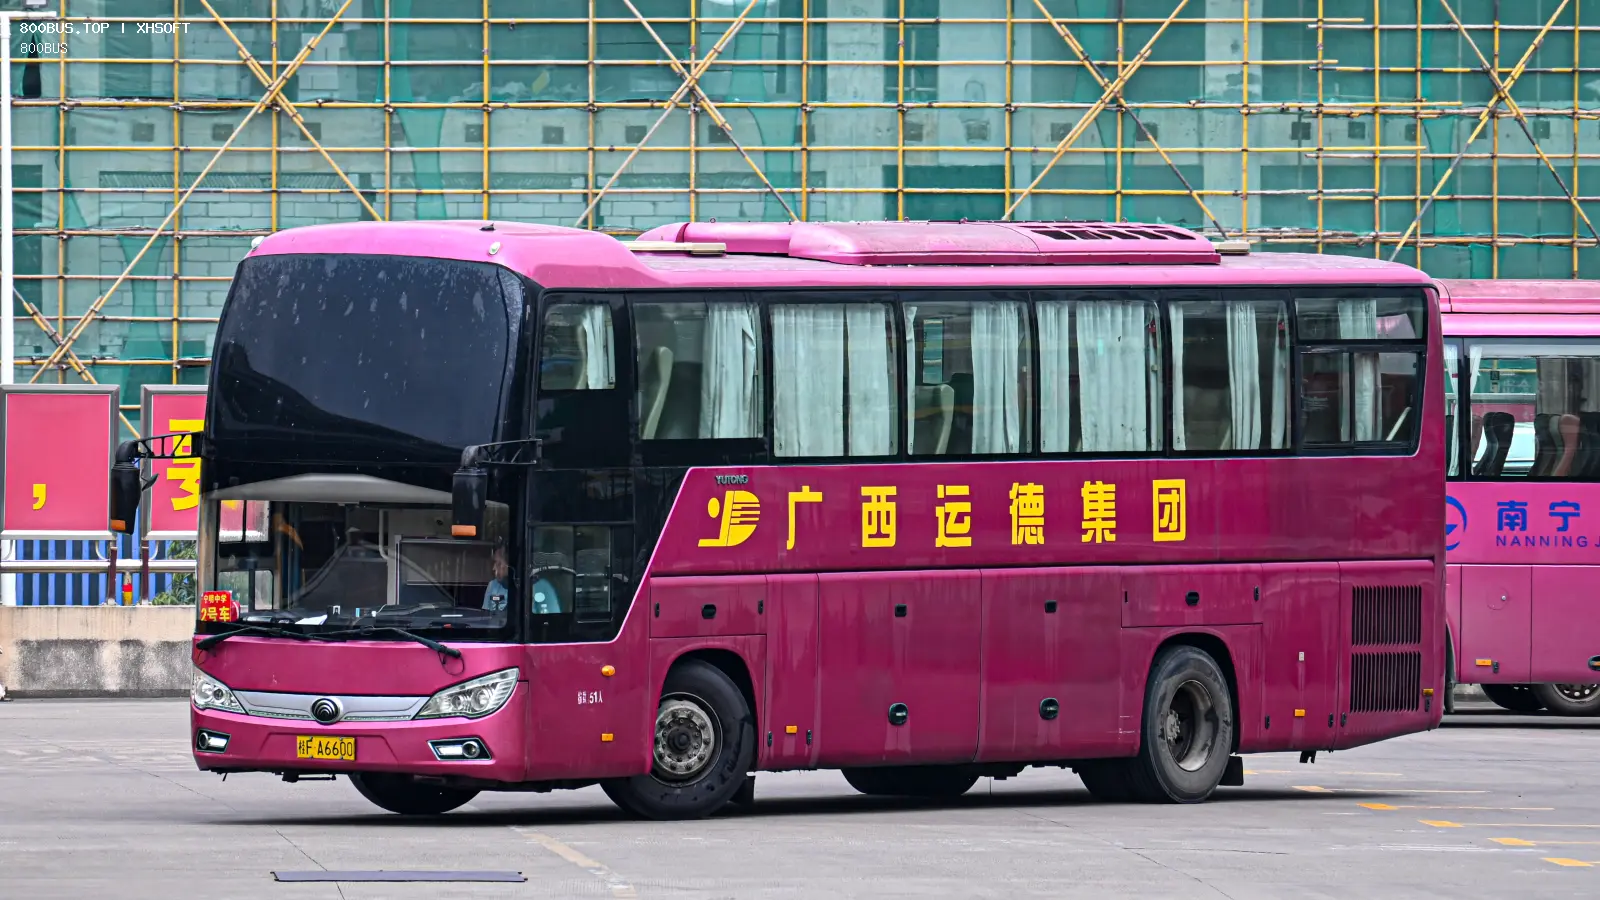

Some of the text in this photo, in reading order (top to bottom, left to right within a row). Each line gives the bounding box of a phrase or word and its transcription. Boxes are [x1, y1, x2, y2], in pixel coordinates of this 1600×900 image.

[715, 474, 749, 485] YUTONG
[786, 478, 1187, 550] 广西运德集团
[1496, 500, 1581, 532] 南宁
[1496, 535, 1588, 548] NANNING
[200, 606, 231, 622] 2号车
